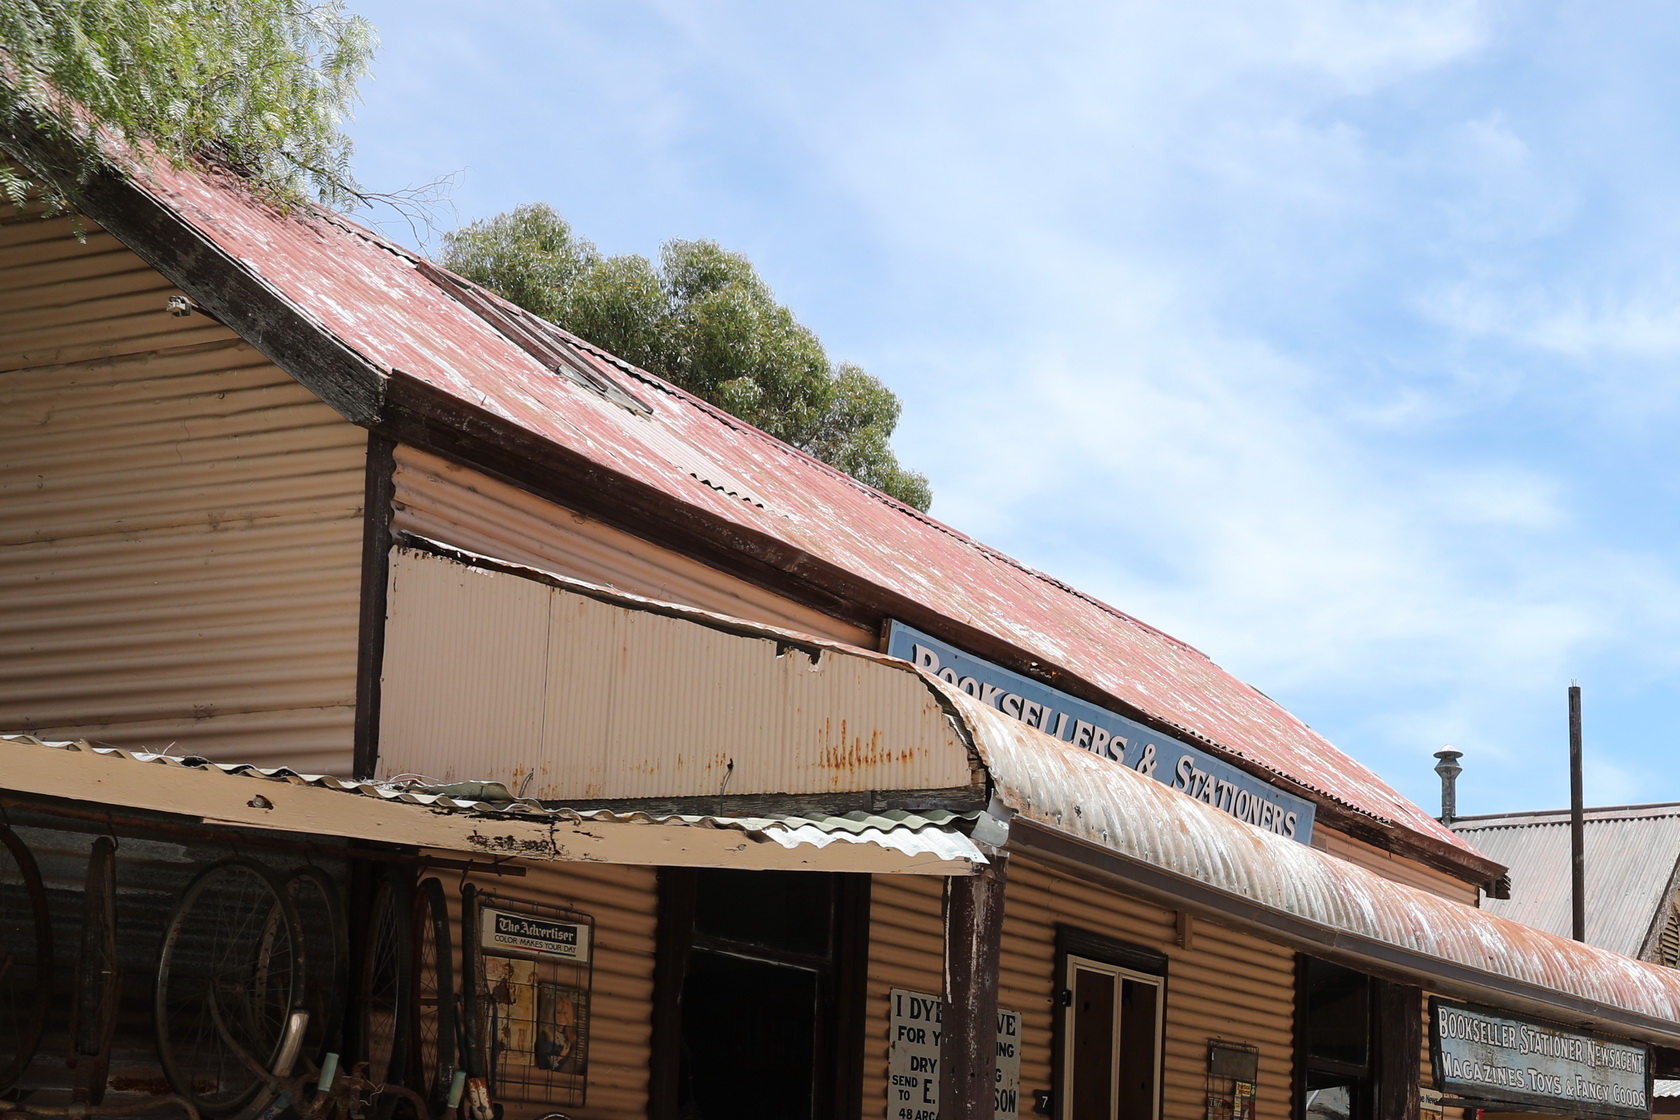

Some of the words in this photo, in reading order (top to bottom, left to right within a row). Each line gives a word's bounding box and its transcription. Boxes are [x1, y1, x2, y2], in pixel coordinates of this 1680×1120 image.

[1136, 743, 1158, 777] &
[1171, 755, 1297, 840] STATIONERS
[498, 917, 520, 933] The
[520, 922, 574, 942] Advertiser
[494, 934, 518, 945] COLOR
[519, 938, 543, 949] MAKES
[543, 941, 562, 952] YOUR
[563, 945, 577, 954] DAY
[896, 994, 902, 1017] I
[898, 1025, 925, 1045] FOR
[932, 1030, 942, 1047] Y
[1438, 1007, 1517, 1050] BOOKSELLER
[1586, 1039, 1644, 1075] NEWSAGENT
[910, 1055, 937, 1074] DRY
[892, 1075, 917, 1088] SEND
[923, 1078, 935, 1104] E.
[1527, 1067, 1562, 1095] TOYS
[1566, 1079, 1575, 1097] &
[1574, 1075, 1609, 1102] FANCY
[1613, 1084, 1646, 1108] GOODS
[898, 1089, 910, 1101] TO
[1041, 1096, 1048, 1108] 7
[899, 1108, 913, 1120] 48
